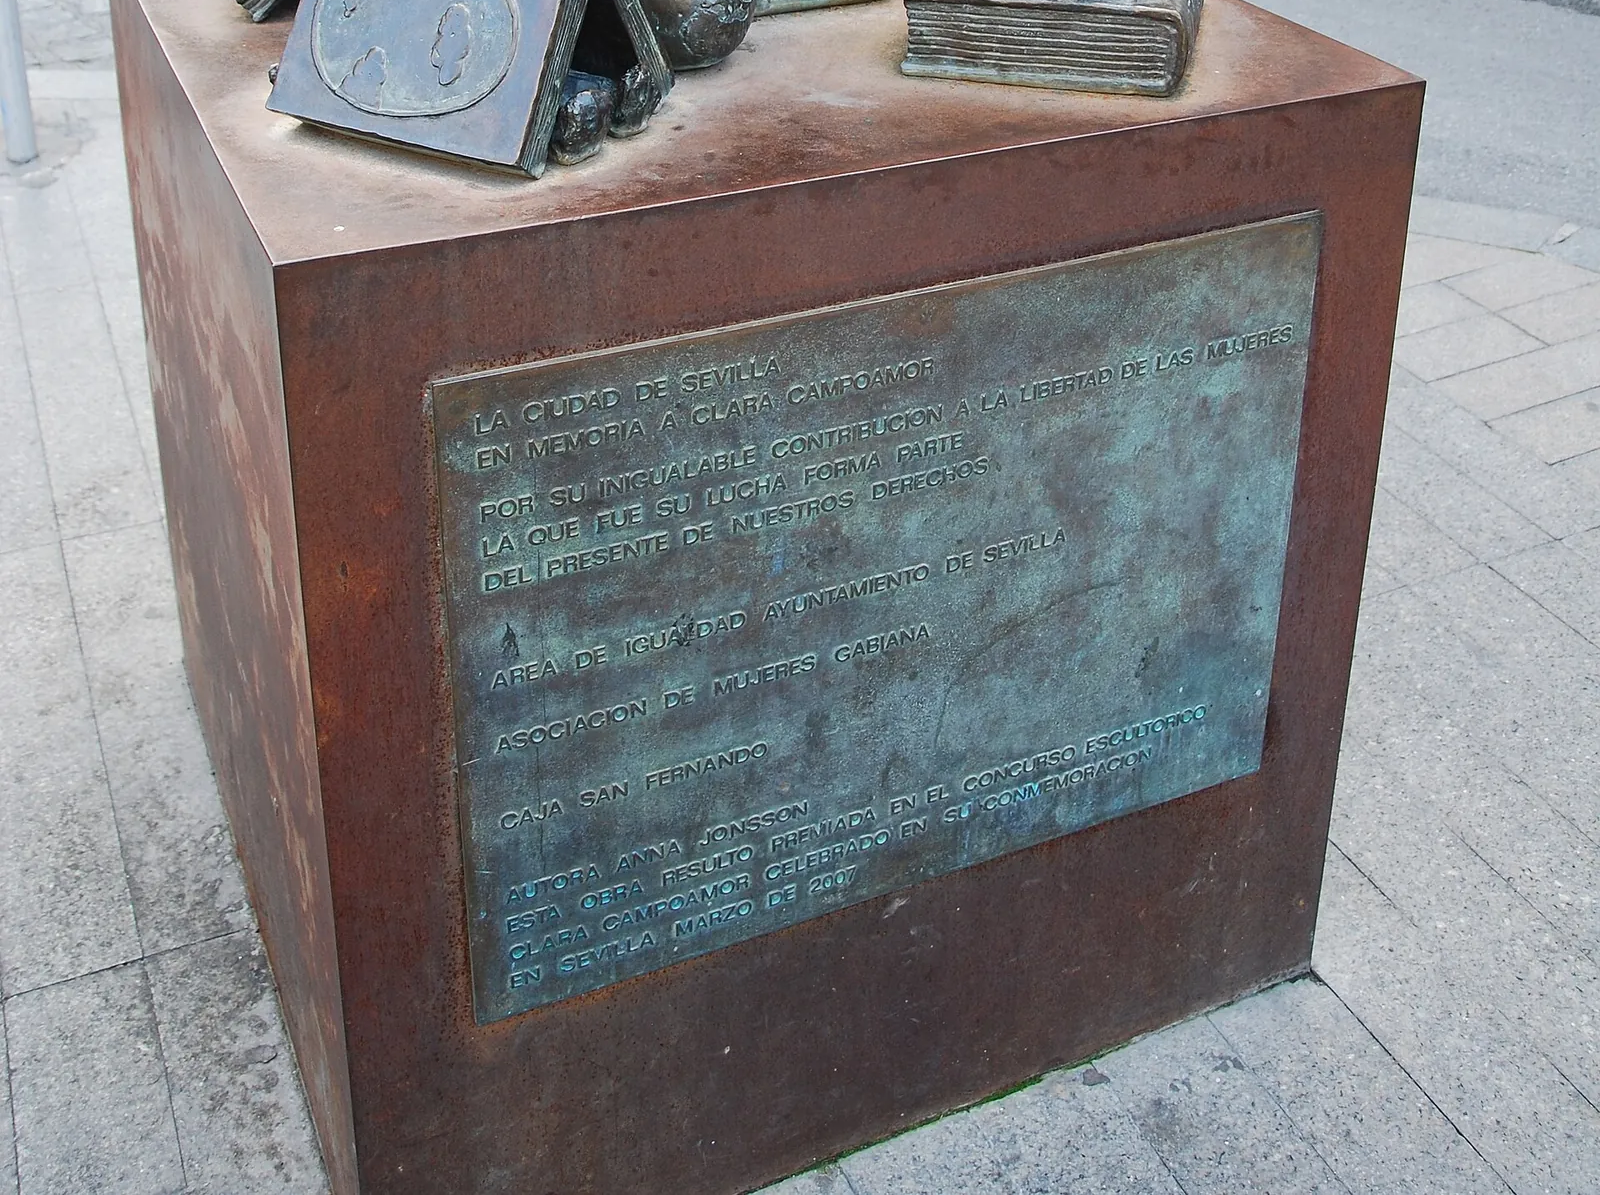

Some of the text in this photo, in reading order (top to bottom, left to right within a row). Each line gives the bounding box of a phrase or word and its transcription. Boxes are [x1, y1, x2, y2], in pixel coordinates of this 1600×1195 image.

[474, 357, 781, 436] LA CIUDAD DE SEVILLA
[477, 357, 935, 469] EN MEMORIA A CLARA CAMPOAMOR
[479, 325, 1293, 524] POR SU INIGUALABLE CONTRIBUCION A LA LIBERTAD DE LAS MUJERES
[481, 432, 963, 558] LA QUE FUE SU LUCHA FORMA PARTE
[484, 456, 990, 592] DEL PRESENTE DE NUESTROS DERECHOS
[491, 528, 1066, 690] AREA DE IGUALDAD AYUNTAMIENTO DE SEVILLA
[495, 624, 930, 755] ASOCIACION DE MUJERES GABIANA
[500, 743, 769, 832] CAJA SAN FERNANDO
[506, 704, 1207, 934] ESTA OBRA RESULTO PREMIADA EN EL CONCURSO ESCULTORICO
[506, 801, 809, 905] AUTORA ANNA JONSSON
[509, 925, 589, 962] CLARA
[603, 875, 750, 932] CAMPOAMOR
[765, 828, 891, 882] CELEBRADO
[900, 817, 928, 839] EN
[944, 801, 971, 824] SU
[510, 866, 859, 990] EN SEVILLA MARZO DE 2007
